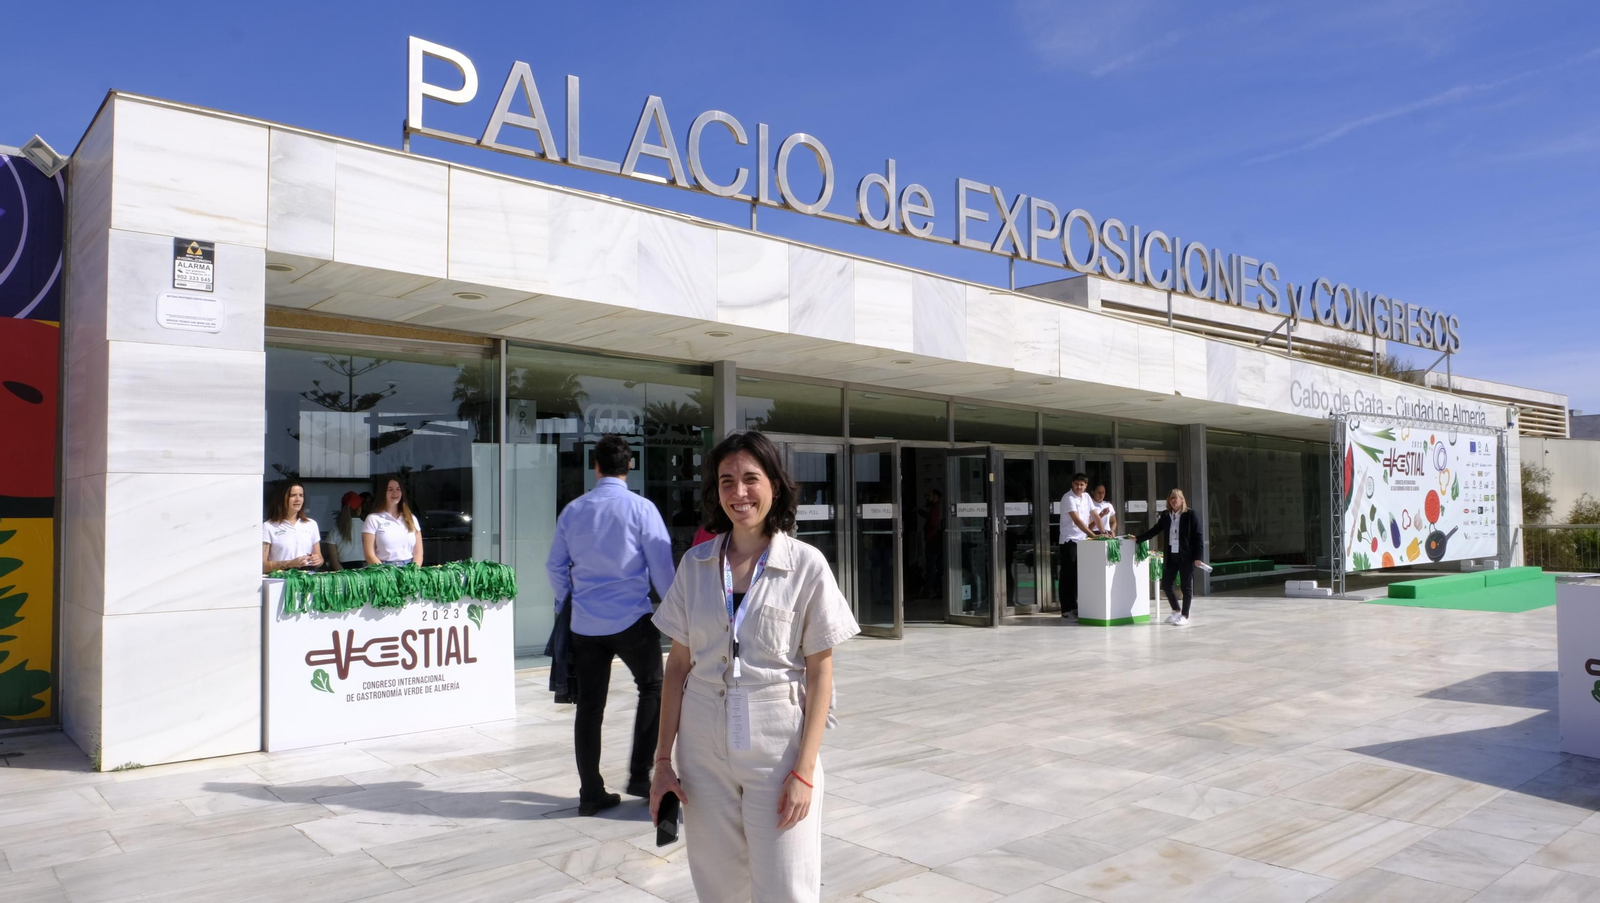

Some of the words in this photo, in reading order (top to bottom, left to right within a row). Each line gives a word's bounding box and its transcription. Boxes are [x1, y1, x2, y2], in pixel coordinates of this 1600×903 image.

[408, 35, 834, 215] PALACIO
[856, 158, 935, 238] de
[956, 177, 1280, 314] EXPOSICIONES
[1287, 282, 1305, 332] y
[1310, 277, 1461, 354] CONGRESOS
[177, 262, 211, 271] ALARMA
[1290, 379, 1329, 411] Cabo
[1333, 387, 1350, 412] de
[1354, 389, 1383, 414] Gata
[1395, 395, 1434, 419] Ciudad
[1437, 401, 1450, 420] de
[1452, 403, 1486, 426] Almería
[662, 437, 671, 445] de
[422, 608, 460, 622] 2023
[362, 679, 397, 690] CONGRESO
[398, 674, 445, 687] INTERNACIONAL
[346, 694, 355, 702] DE
[356, 687, 402, 701] GASTRONOMÍA
[404, 686, 423, 696] VERDE
[425, 685, 433, 694] DE
[434, 682, 460, 692] ALMERÍA
